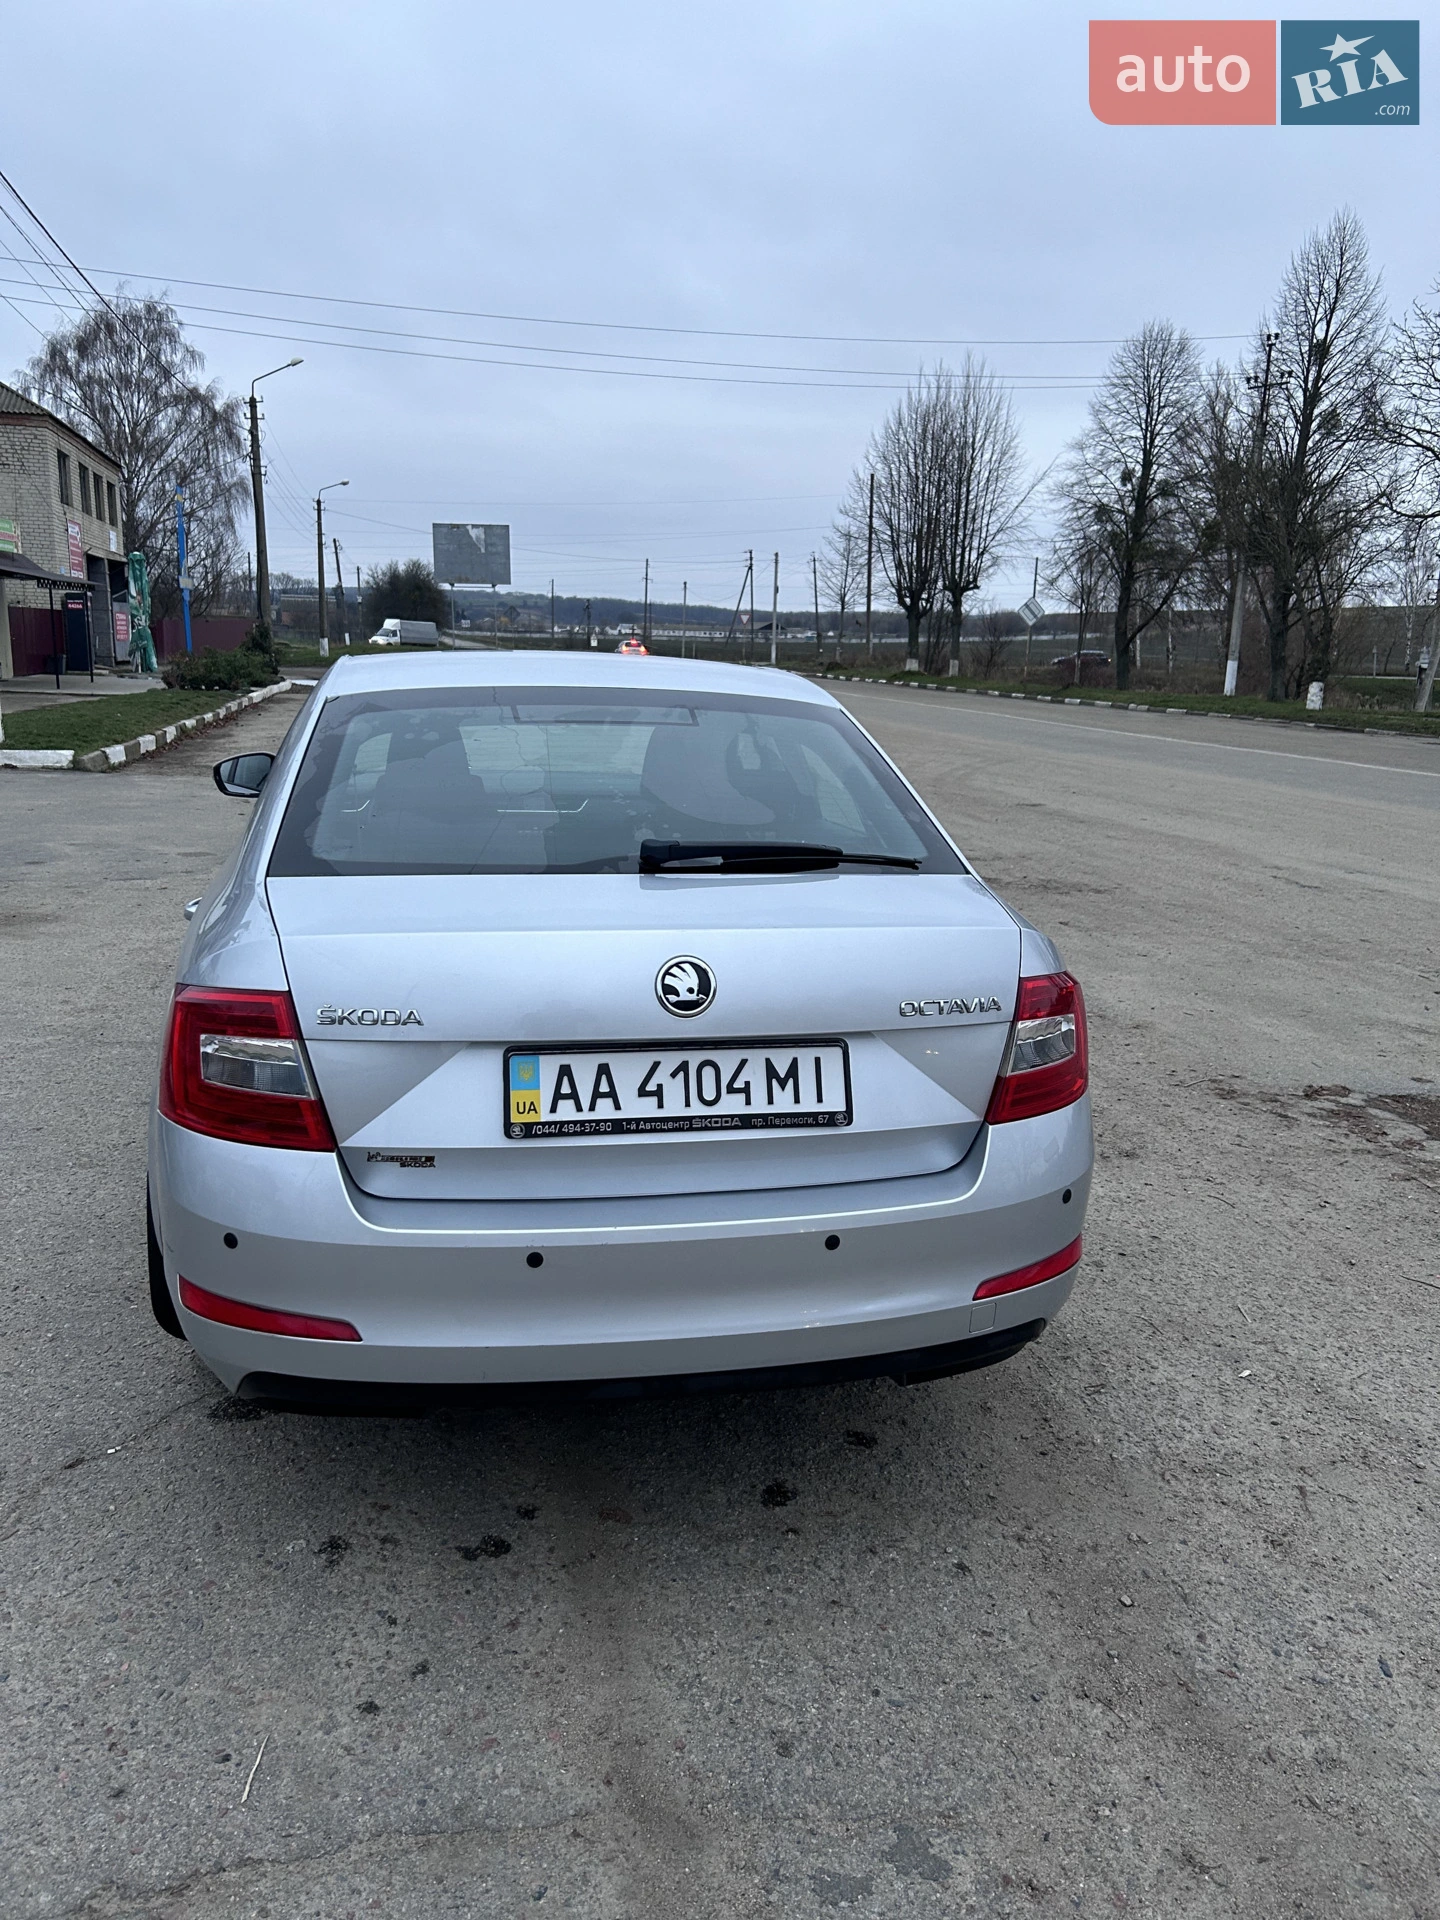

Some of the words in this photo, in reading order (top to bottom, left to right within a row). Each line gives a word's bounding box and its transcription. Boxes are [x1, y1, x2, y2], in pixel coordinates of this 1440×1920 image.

[899, 996, 1002, 1017] OCTAVIA
[637, 1058, 752, 1110] 4104
[516, 1101, 538, 1115] UA
[561, 1121, 613, 1134] 494-37-90
[638, 1119, 690, 1131] Автоцентр
[818, 1114, 830, 1124] 67
